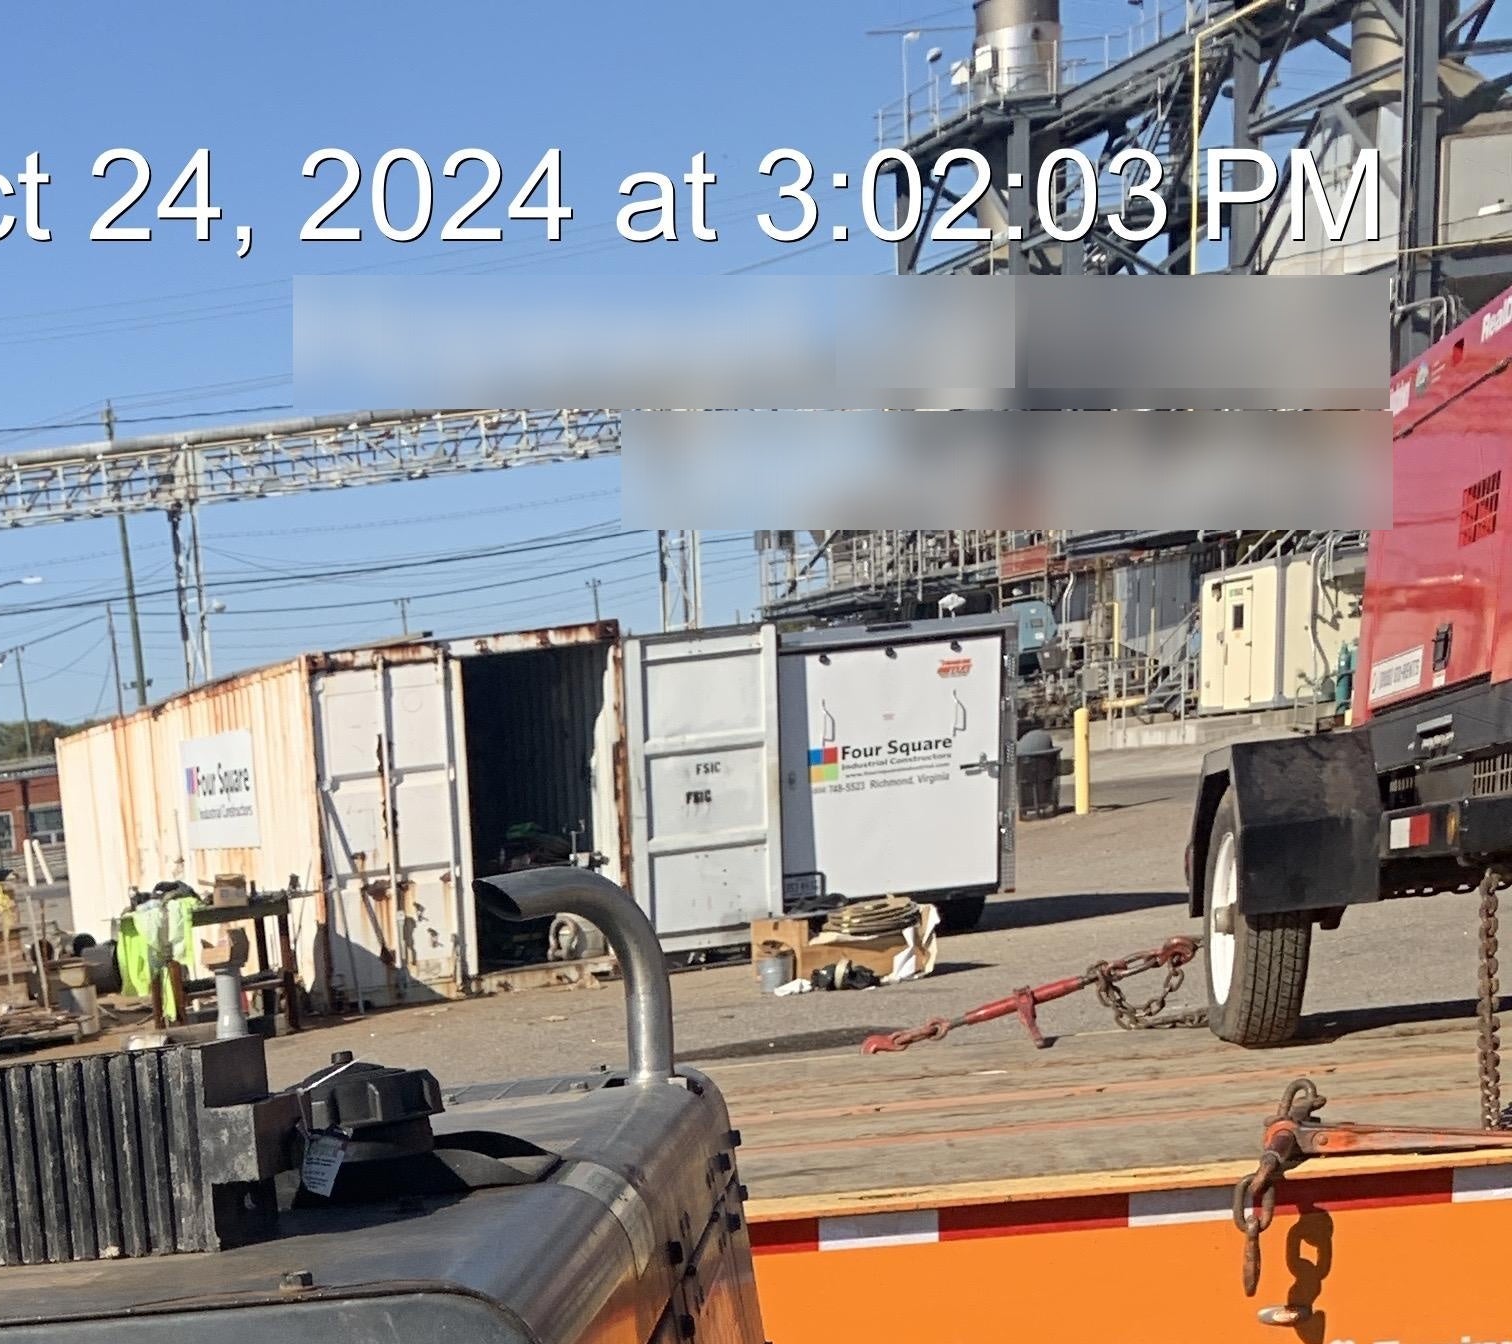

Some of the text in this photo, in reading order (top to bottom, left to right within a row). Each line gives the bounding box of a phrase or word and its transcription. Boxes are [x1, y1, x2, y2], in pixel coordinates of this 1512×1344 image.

[841, 738, 953, 760] Four Square
[695, 762, 721, 775] FSIC
[196, 762, 250, 802] Four Square
